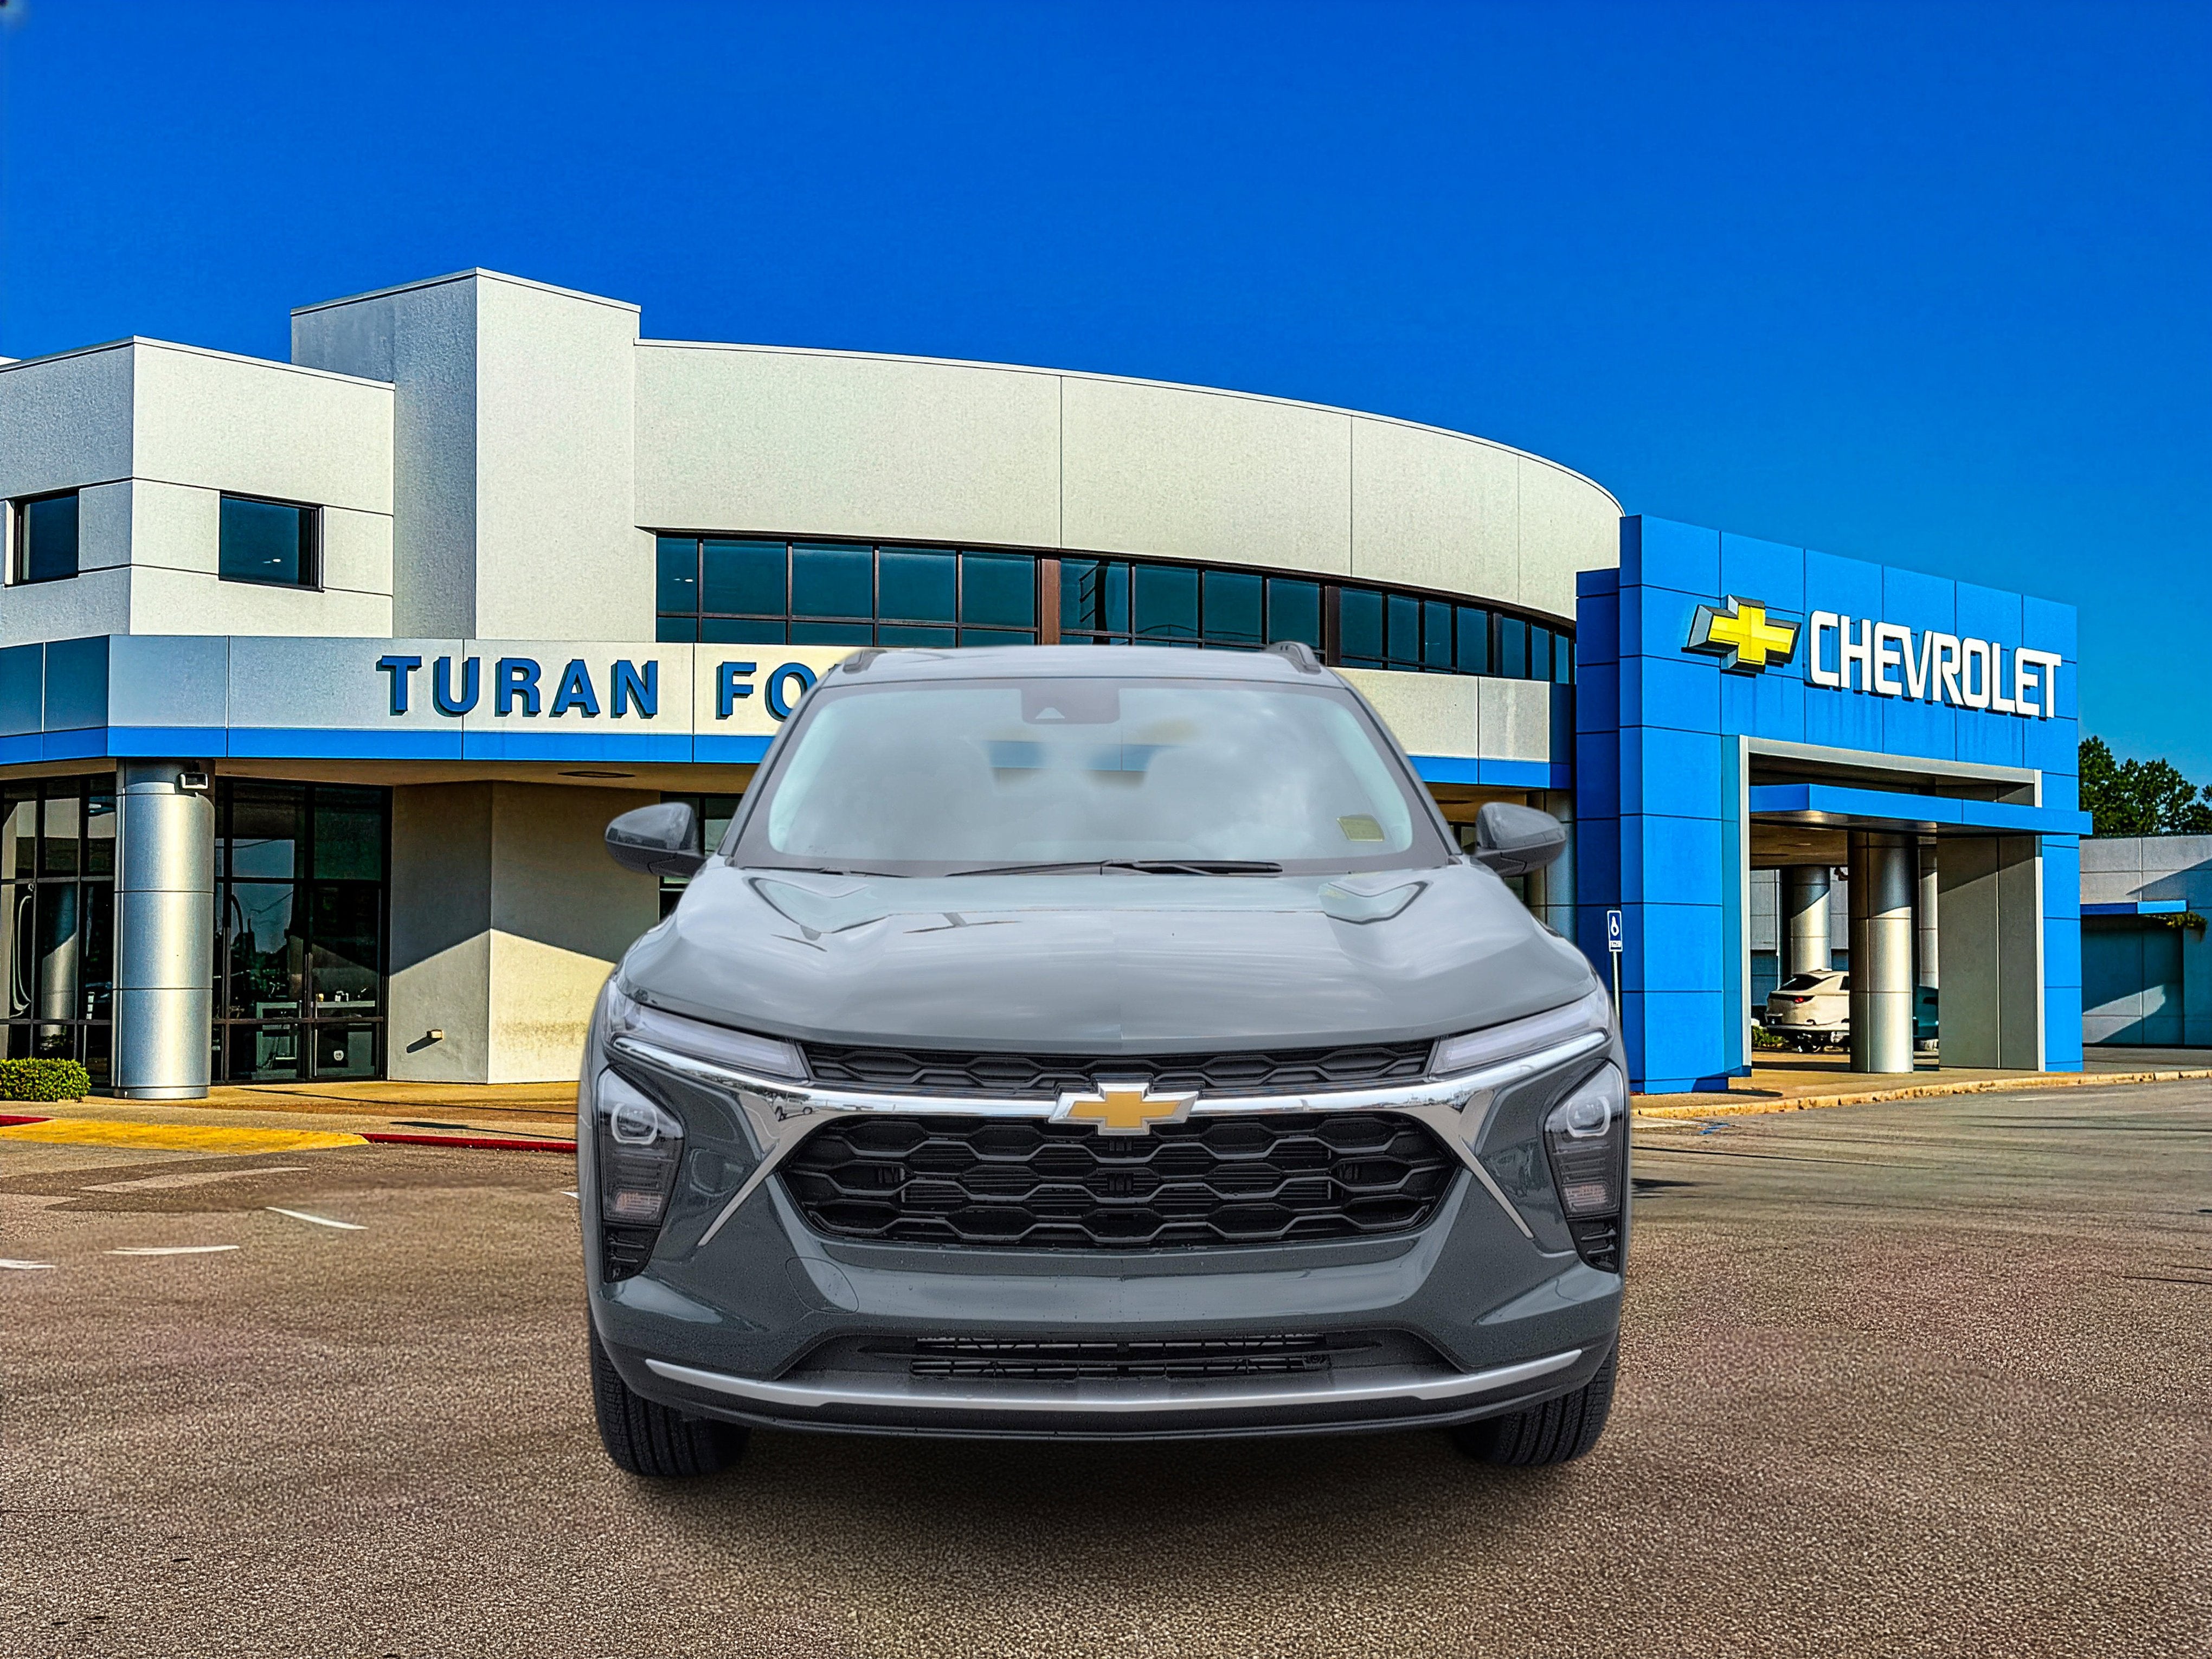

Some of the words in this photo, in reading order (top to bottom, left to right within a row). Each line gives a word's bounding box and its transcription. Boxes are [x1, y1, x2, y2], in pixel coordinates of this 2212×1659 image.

[376, 655, 658, 719] TURAN
[716, 661, 840, 722] FO
[1808, 610, 2062, 719] CHEVROLET
